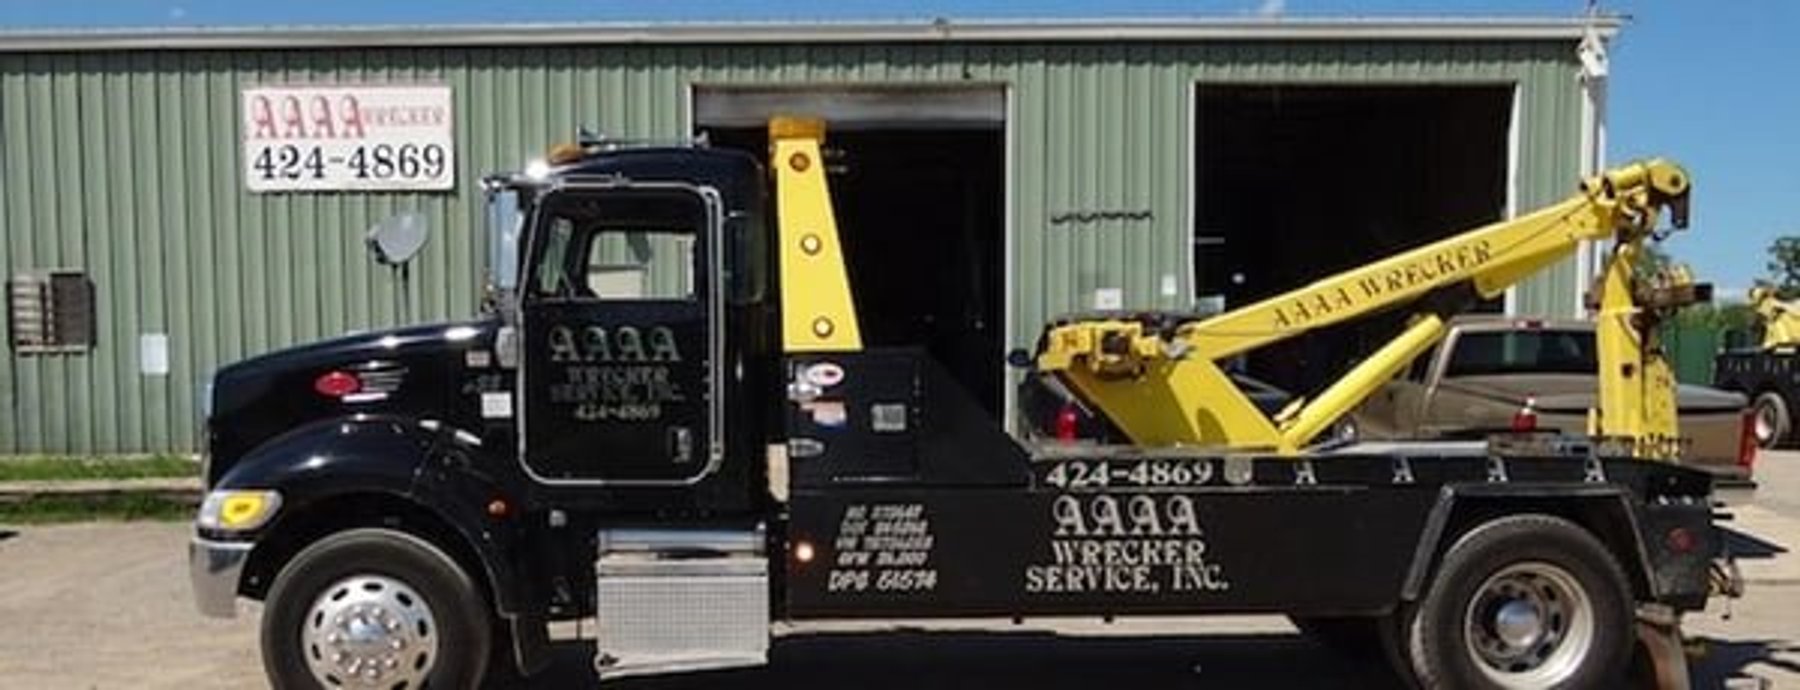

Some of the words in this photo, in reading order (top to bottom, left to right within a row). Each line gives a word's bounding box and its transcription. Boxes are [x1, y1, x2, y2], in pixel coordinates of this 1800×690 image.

[252, 94, 366, 139] AAAA
[254, 143, 445, 179] 424-4869
[1271, 286, 1354, 329] AAAA
[1358, 239, 1491, 299] WRECKER
[1046, 461, 1213, 488] 424-4869
[1052, 494, 1203, 536] AAAA
[1052, 540, 1205, 566] WRECKER
[1025, 564, 1160, 593] SERVICE,
[1172, 564, 1230, 590] INC.
